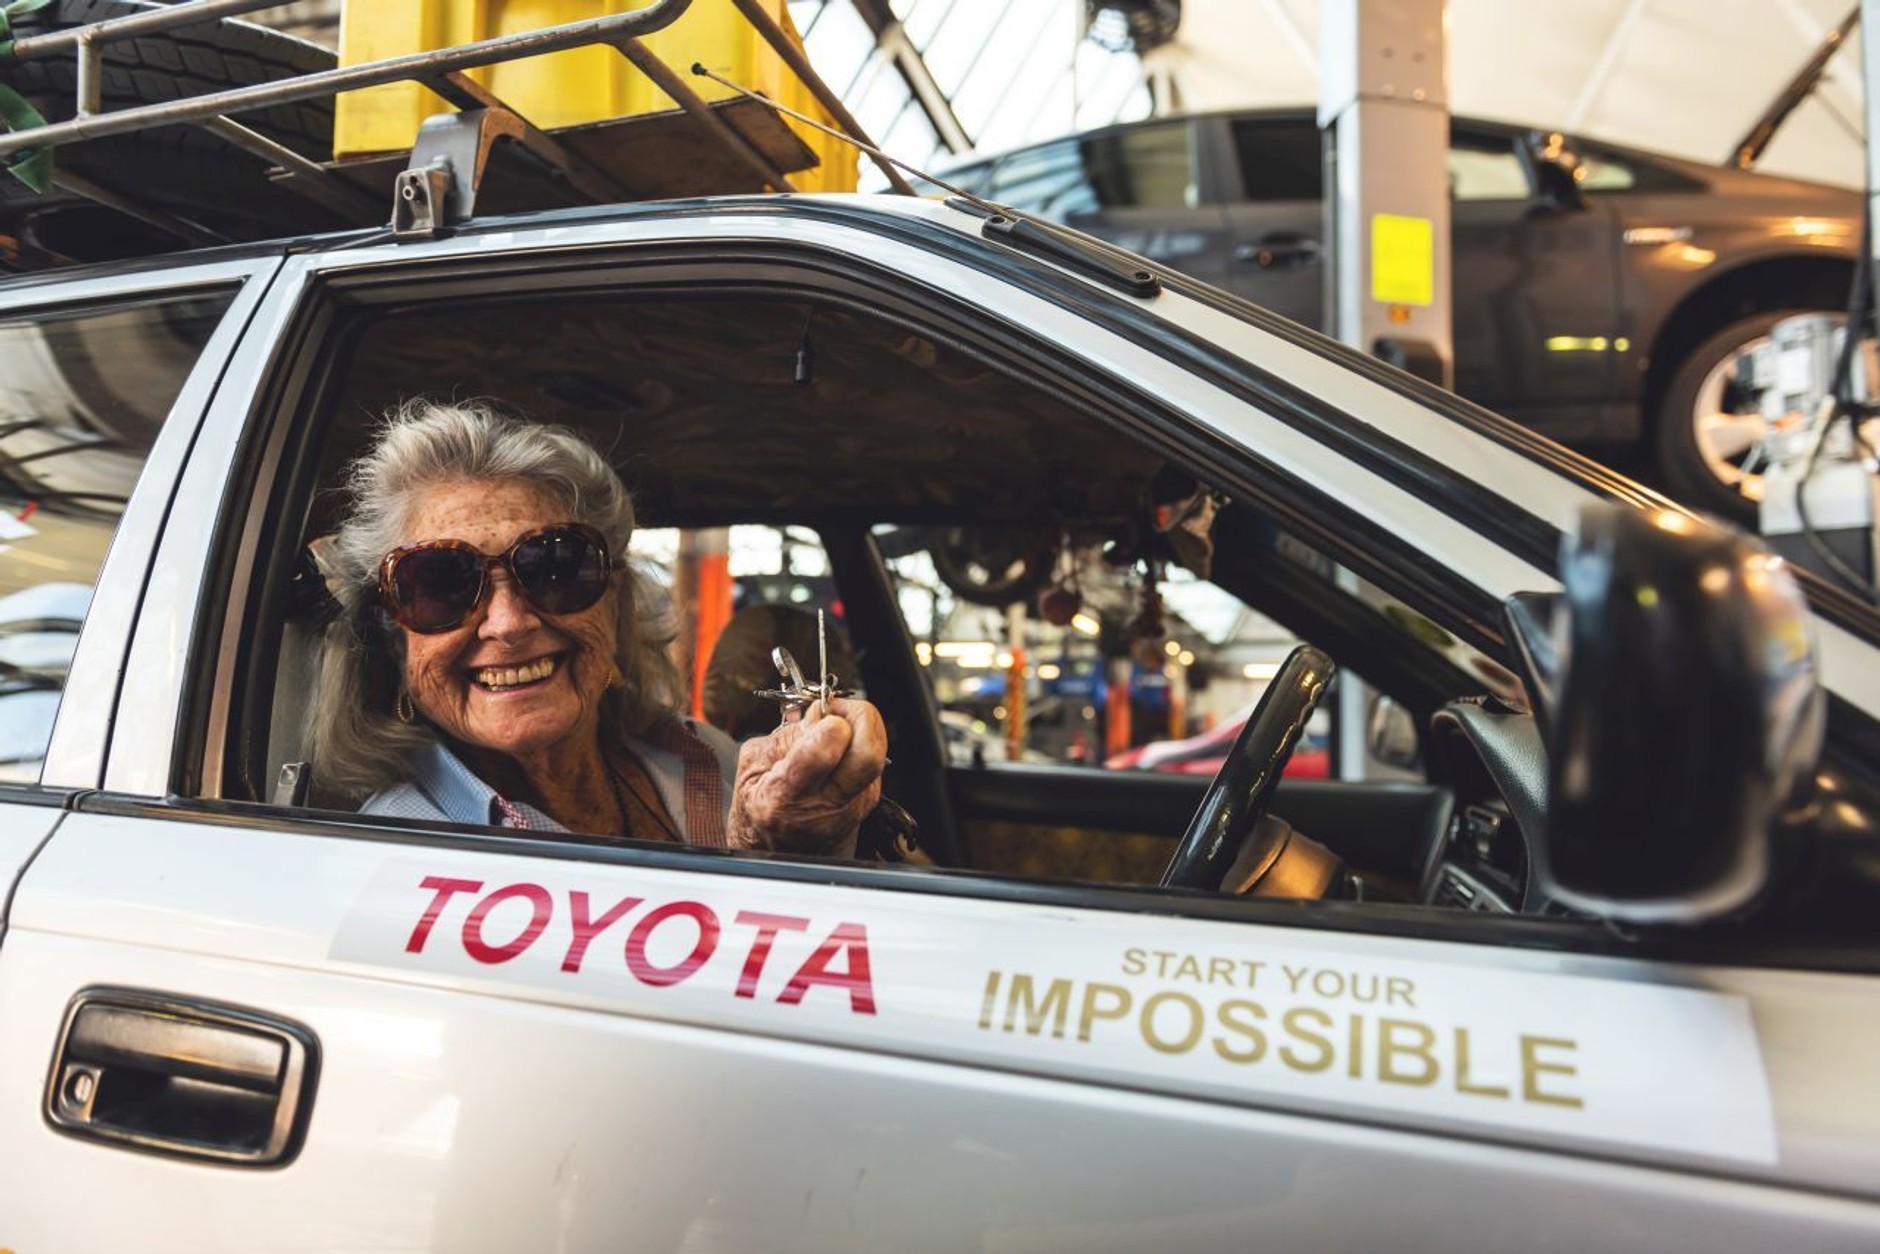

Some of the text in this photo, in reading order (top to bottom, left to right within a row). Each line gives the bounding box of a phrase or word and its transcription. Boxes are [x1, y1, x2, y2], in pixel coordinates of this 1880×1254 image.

[404, 876, 878, 1015] TOYOTA
[1121, 948, 1416, 1007] START YOUR
[977, 970, 1585, 1109] IMPOSSIBLE
